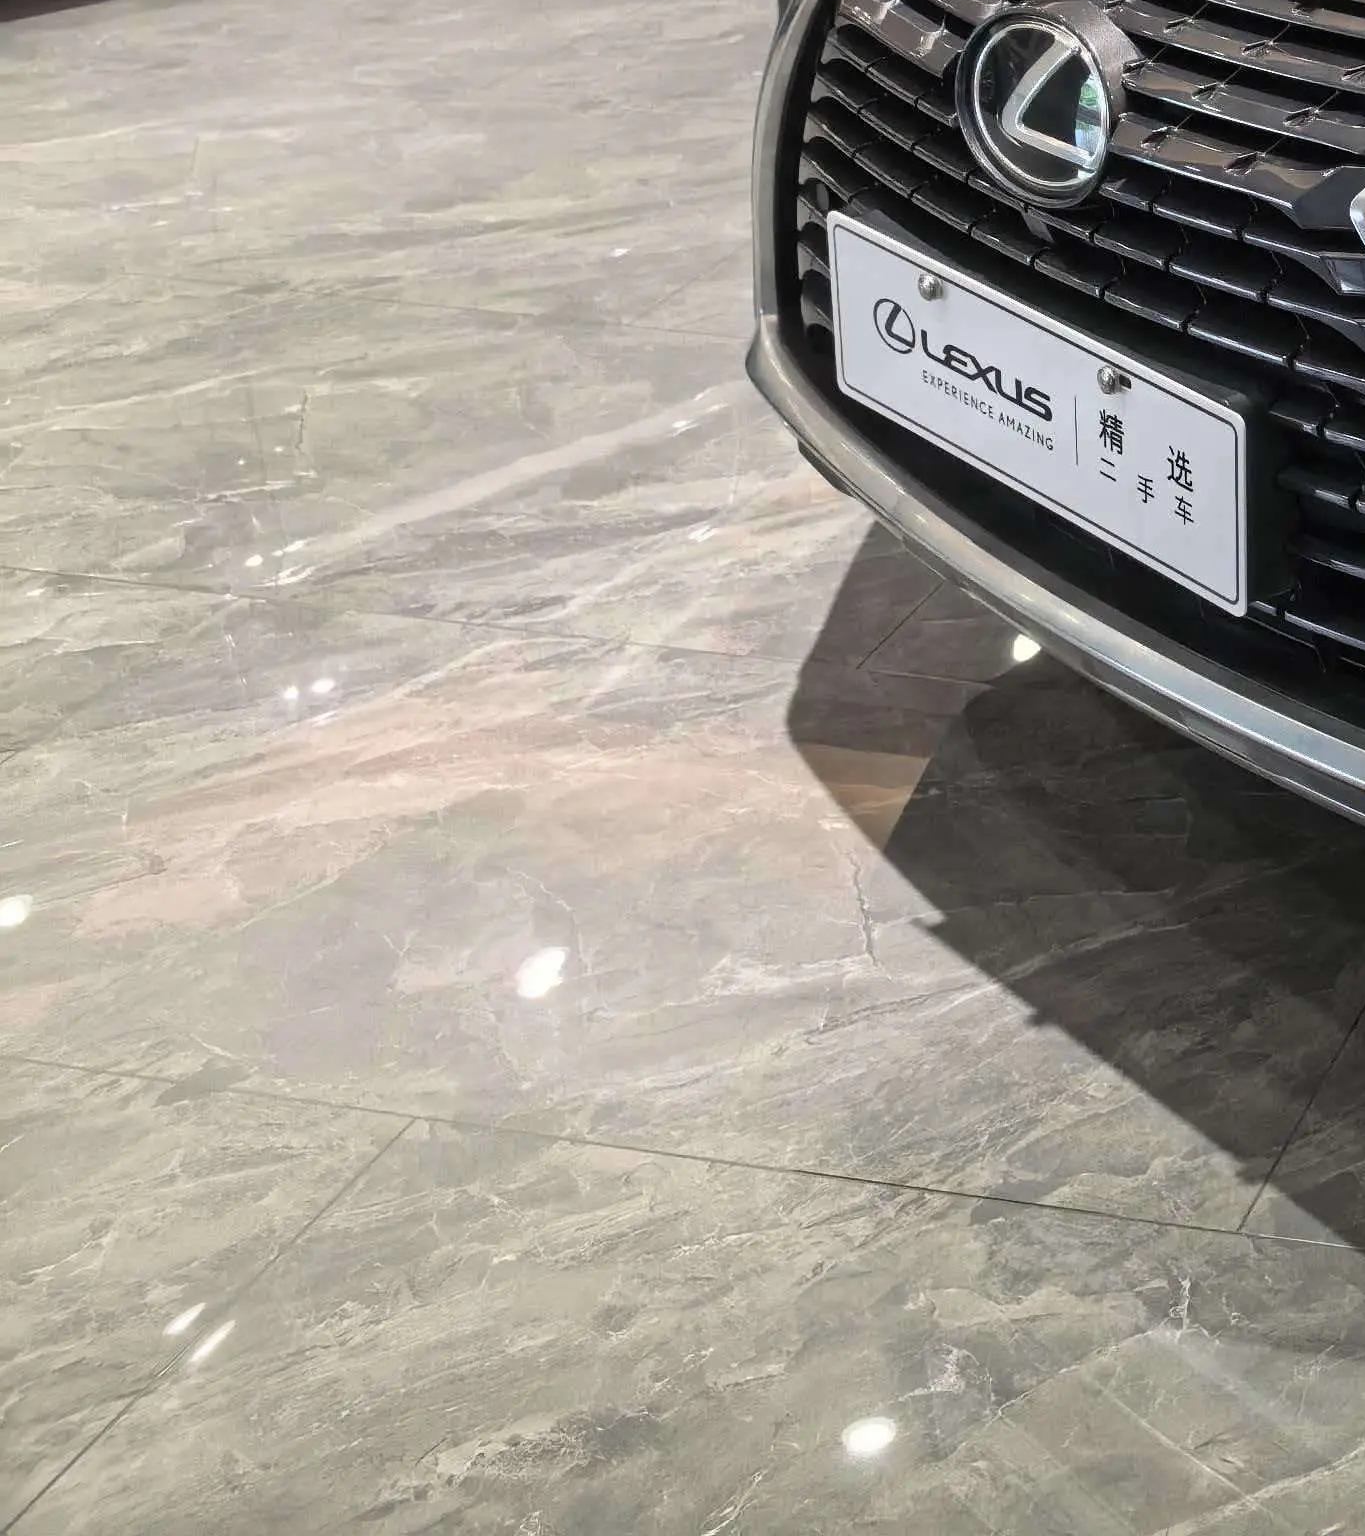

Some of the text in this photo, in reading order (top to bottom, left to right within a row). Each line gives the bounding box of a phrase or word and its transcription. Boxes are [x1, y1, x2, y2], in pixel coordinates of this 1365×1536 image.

[920, 328, 1053, 423] LEXUS
[922, 369, 1055, 452] EXPERIENCE AMAZING
